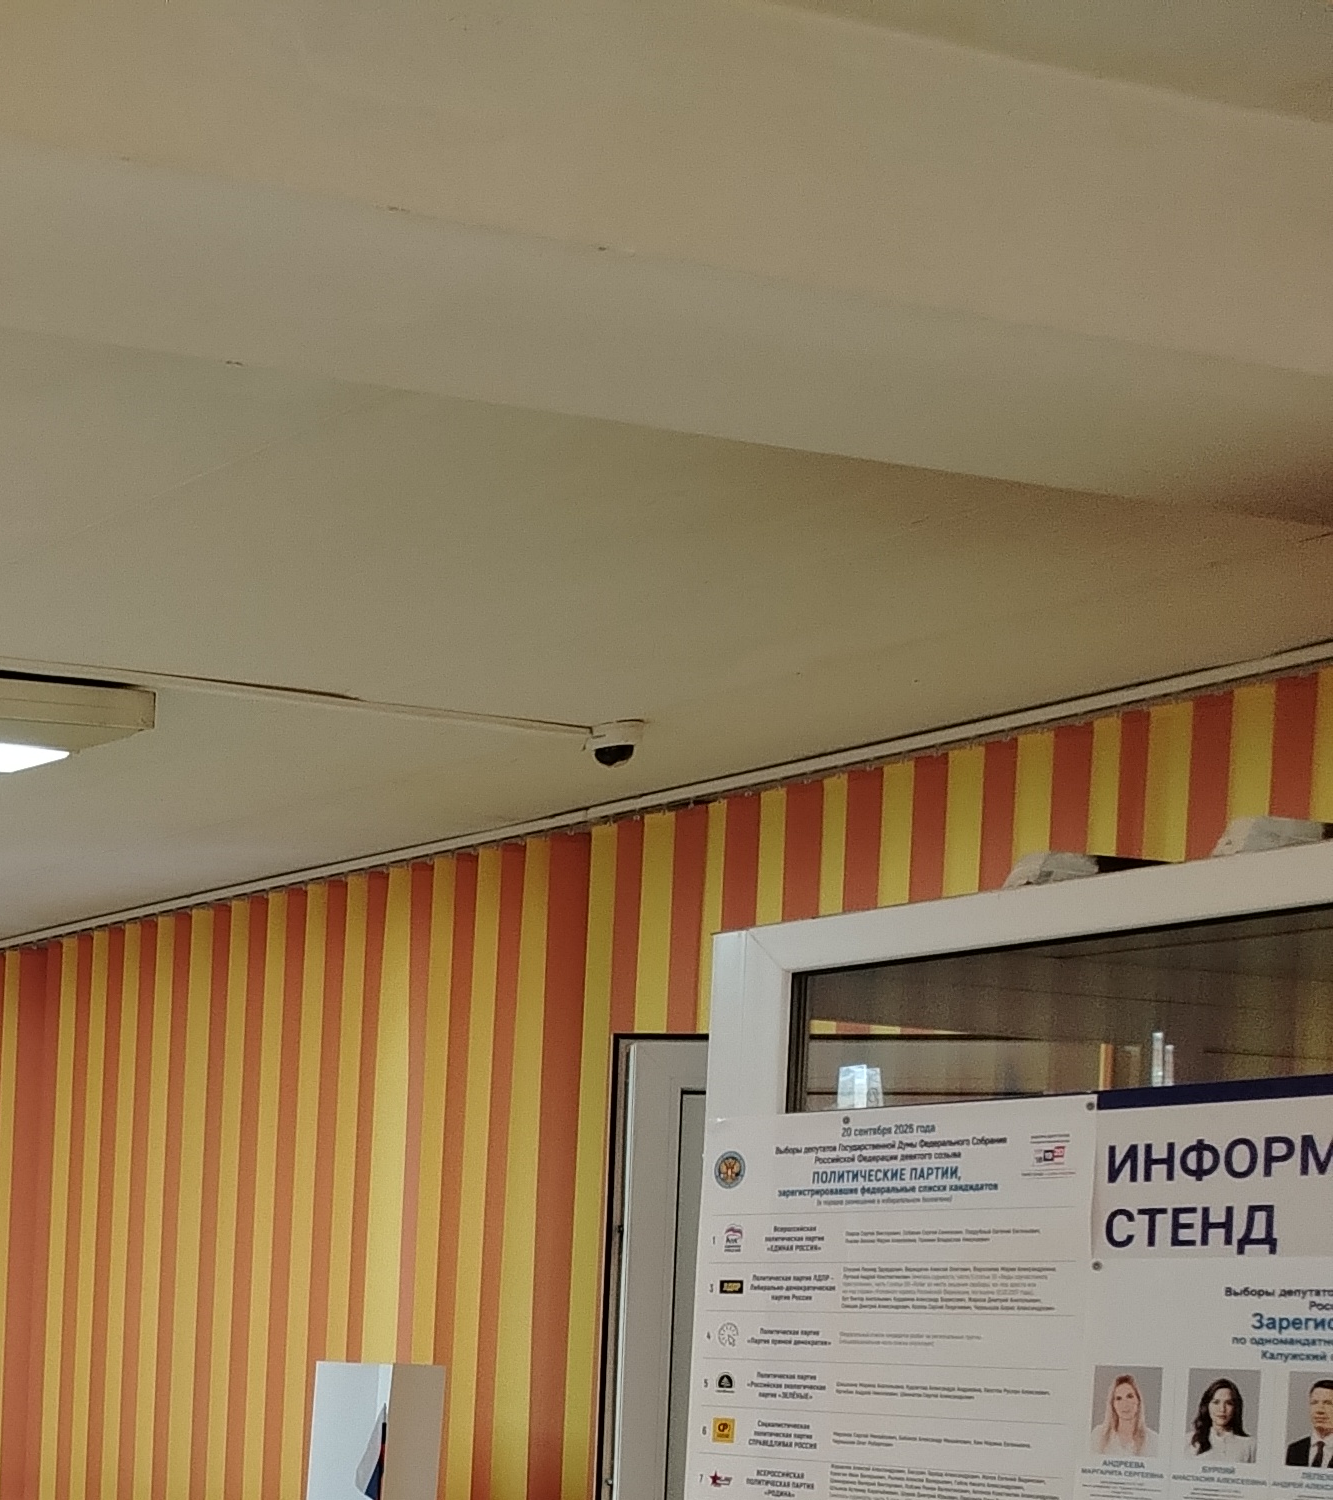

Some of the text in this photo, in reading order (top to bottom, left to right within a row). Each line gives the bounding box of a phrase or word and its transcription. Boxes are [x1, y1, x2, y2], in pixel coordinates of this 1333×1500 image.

[841, 1127, 852, 1137] 20
[854, 1125, 892, 1138] сентября
[916, 1123, 935, 1134] года
[775, 1136, 1007, 1155] Выборы депутатов Государственной Думы Федерального Собрания
[814, 1153, 855, 1165] Российской
[857, 1152, 897, 1164] Федерации
[899, 1151, 933, 1162] девятого
[1107, 1134, 1333, 1183] ИНФОРМ
[812, 1166, 961, 1184] ПОЛИТИЧЕСКИЕ ПАРТИИ,
[778, 1182, 998, 1198] зарегистрировавшие федеральные списки кандидатов
[1105, 1205, 1277, 1255] СТЕНД
[752, 1274, 791, 1282] Политическая
[1224, 1286, 1275, 1298] Выборы
[707, 1332, 711, 1340] 4
[1232, 1337, 1247, 1345] по
[1261, 1350, 1327, 1363] Калужский
[757, 1372, 795, 1380] Политическая
[704, 1379, 708, 1388] 5
[702, 1426, 707, 1435] 6
[1102, 1459, 1145, 1469] АНДРЕЕВА
[756, 1469, 804, 1479] ВСЕРОССИЙСКАЯ
[746, 1478, 814, 1490] ПОЛИТИЧЕСКАЯ ПАРТИЯ
